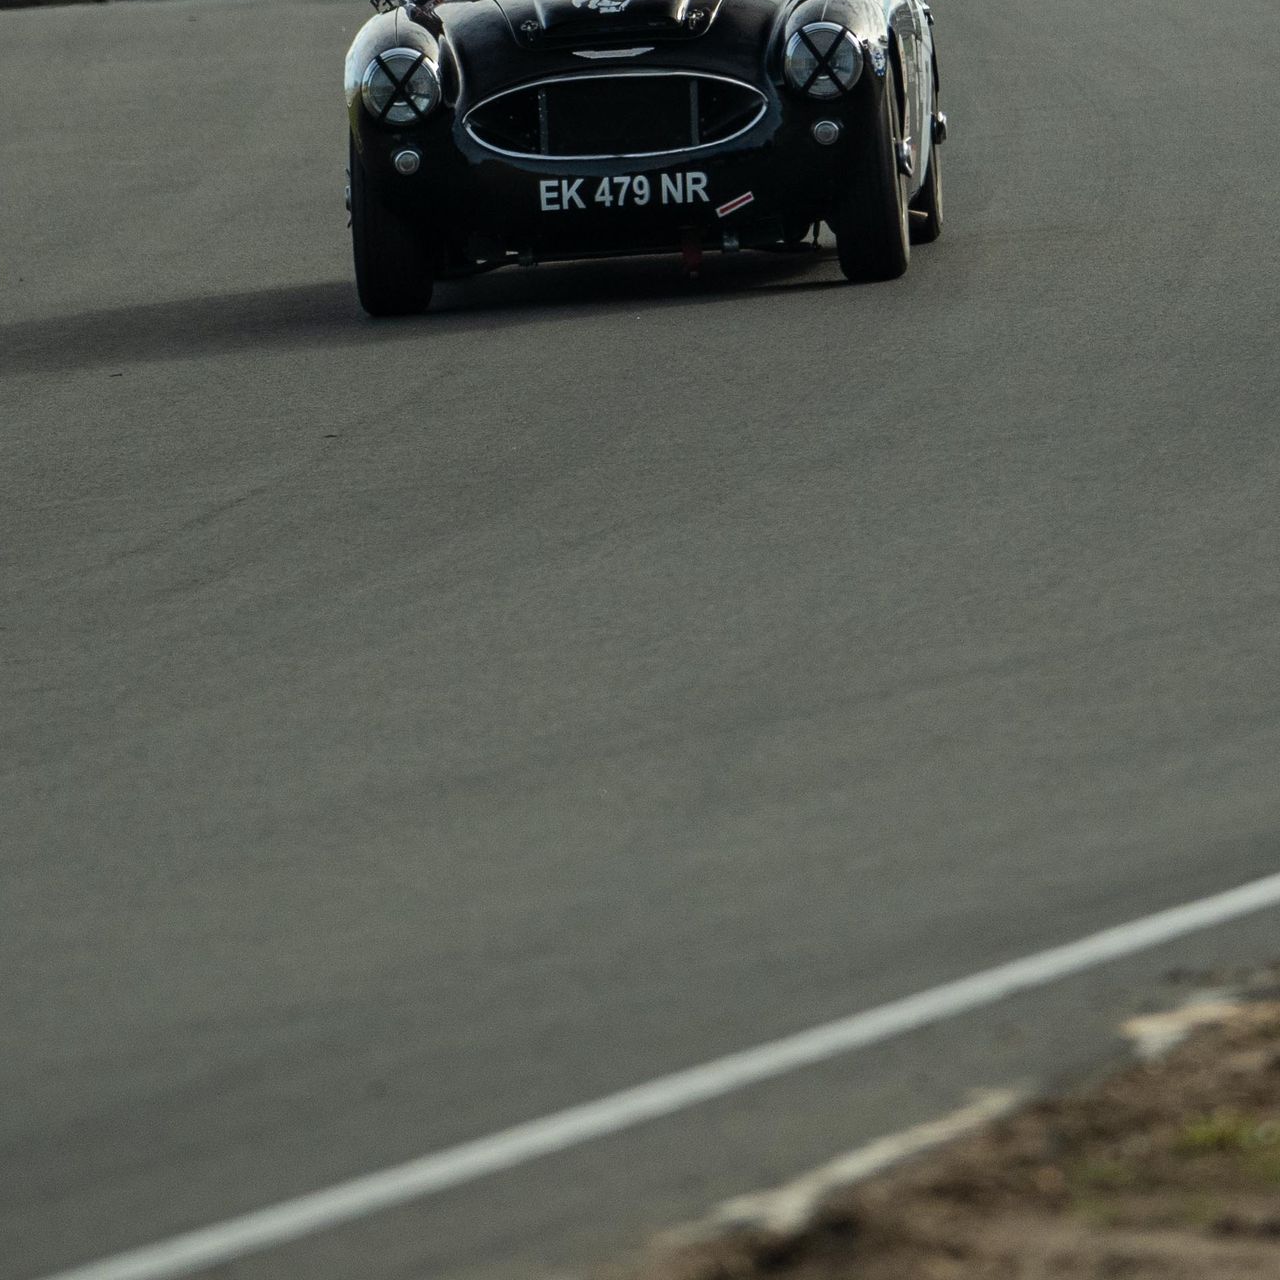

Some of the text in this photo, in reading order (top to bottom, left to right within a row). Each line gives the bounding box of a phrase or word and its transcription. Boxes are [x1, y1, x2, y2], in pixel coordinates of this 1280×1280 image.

[539, 171, 711, 211] EK 479 NR
